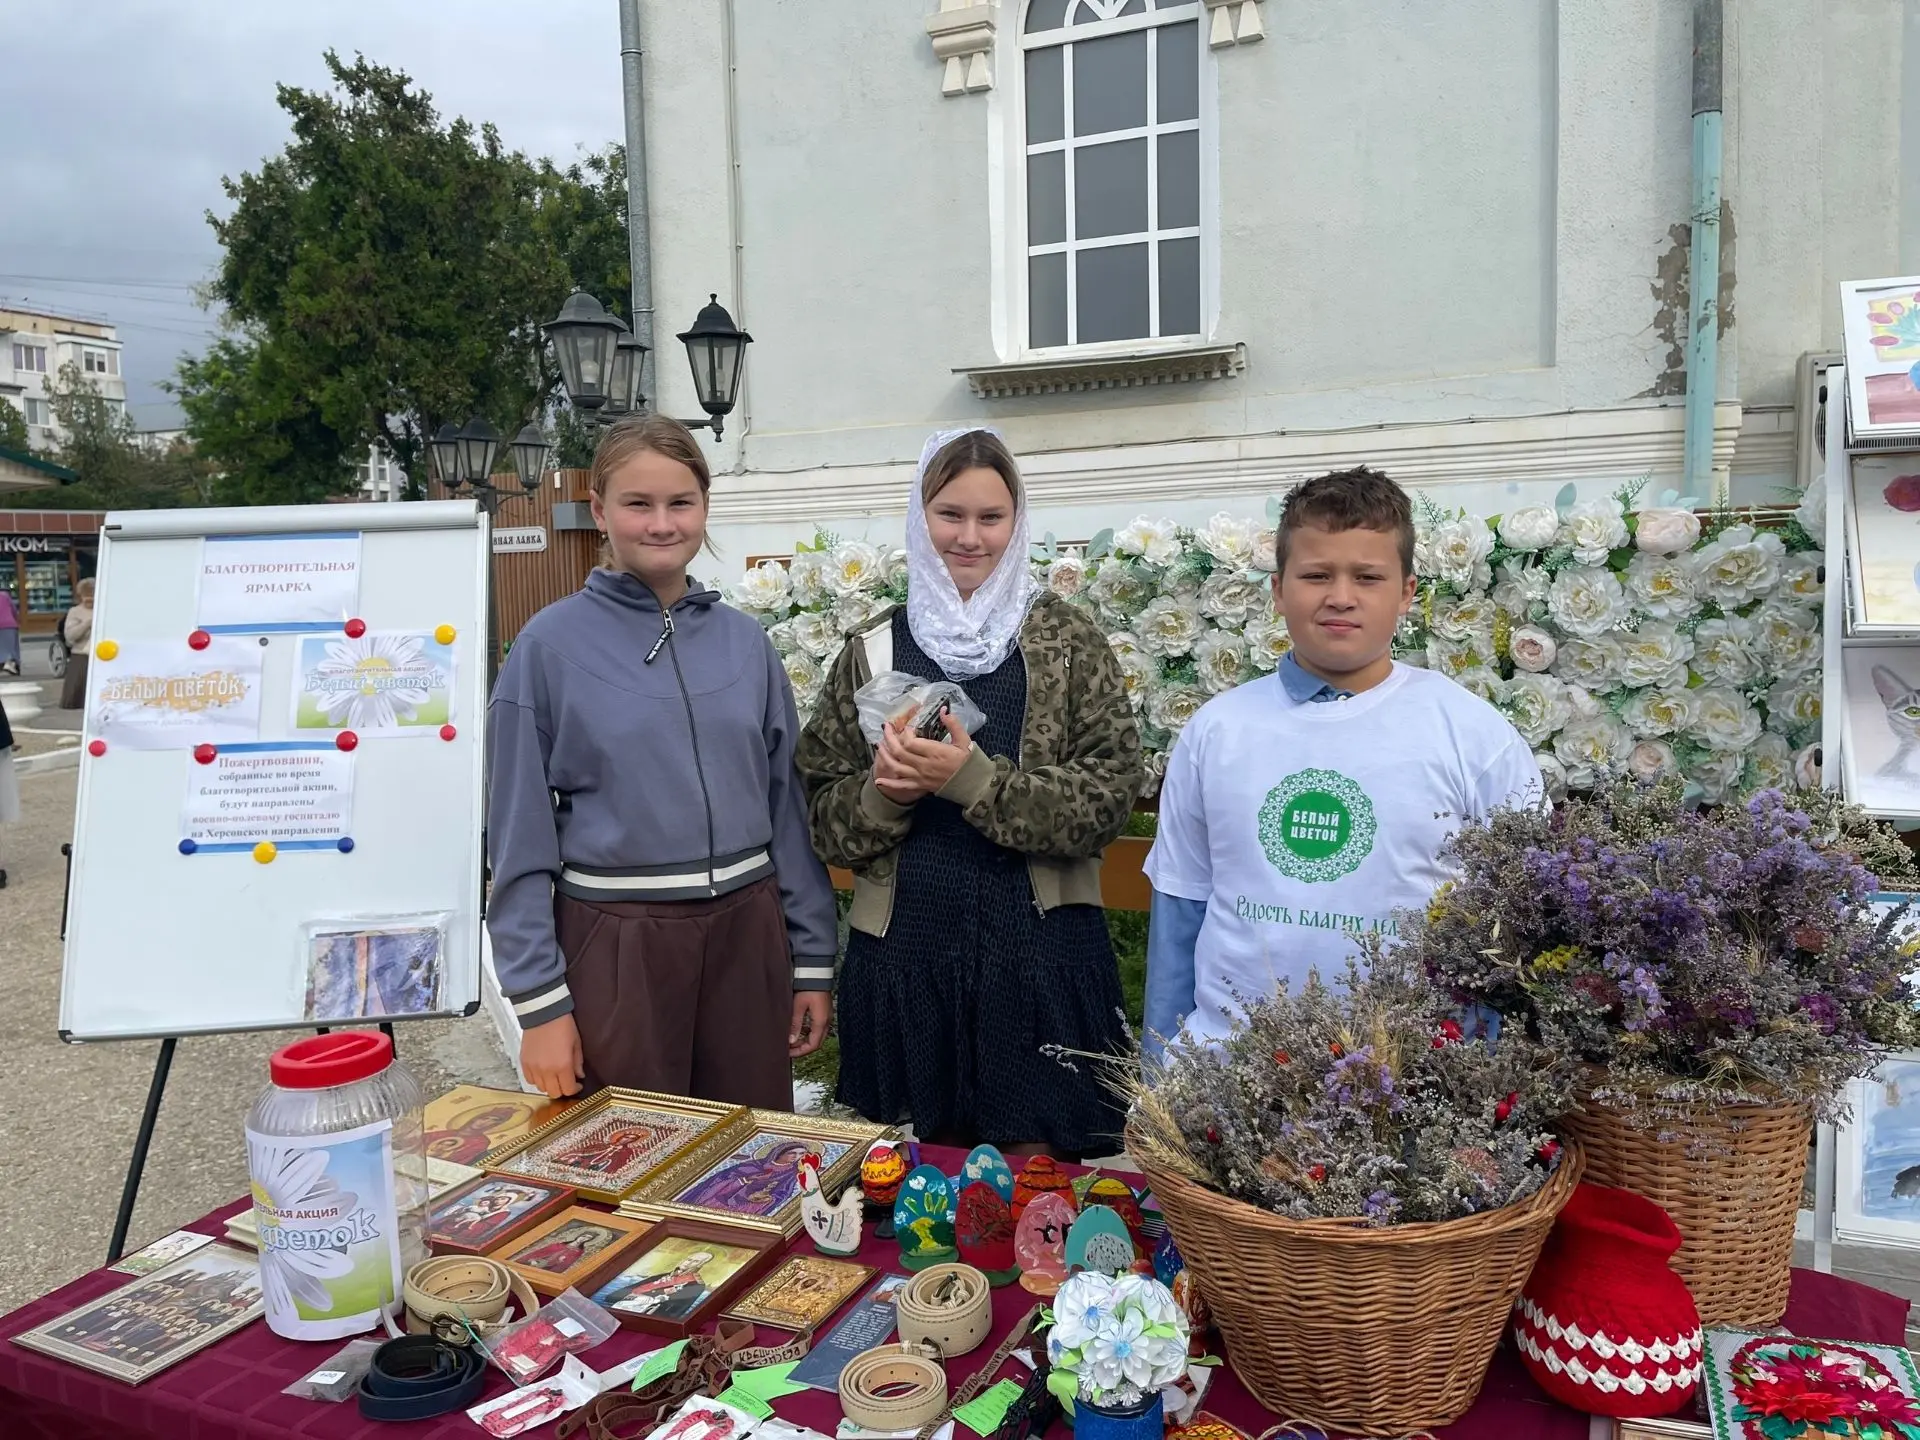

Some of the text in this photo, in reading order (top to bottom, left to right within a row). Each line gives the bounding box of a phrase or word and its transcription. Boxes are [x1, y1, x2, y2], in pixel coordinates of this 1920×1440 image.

[516, 535, 542, 544] ЛАВКА
[204, 562, 355, 575] БЛАГОТВОРИТЕЛЬНАЯ
[245, 582, 312, 594] ЯРМАРКА
[173, 679, 240, 699] ЦВЕТОК
[219, 756, 324, 770] Пожертвования,
[218, 772, 273, 781] собранные
[290, 770, 321, 780] время
[200, 784, 338, 796] благотворительной акции,
[220, 800, 315, 811] будут направлены
[192, 812, 340, 824] военно-полевому госпиталю
[1292, 809, 1340, 827] БЕЛЫЙ
[205, 828, 268, 839] Херсонском
[271, 826, 340, 837] направлении
[1290, 826, 1338, 842] ЦВЕТОК
[296, 1207, 338, 1220] АКЦИЯ
